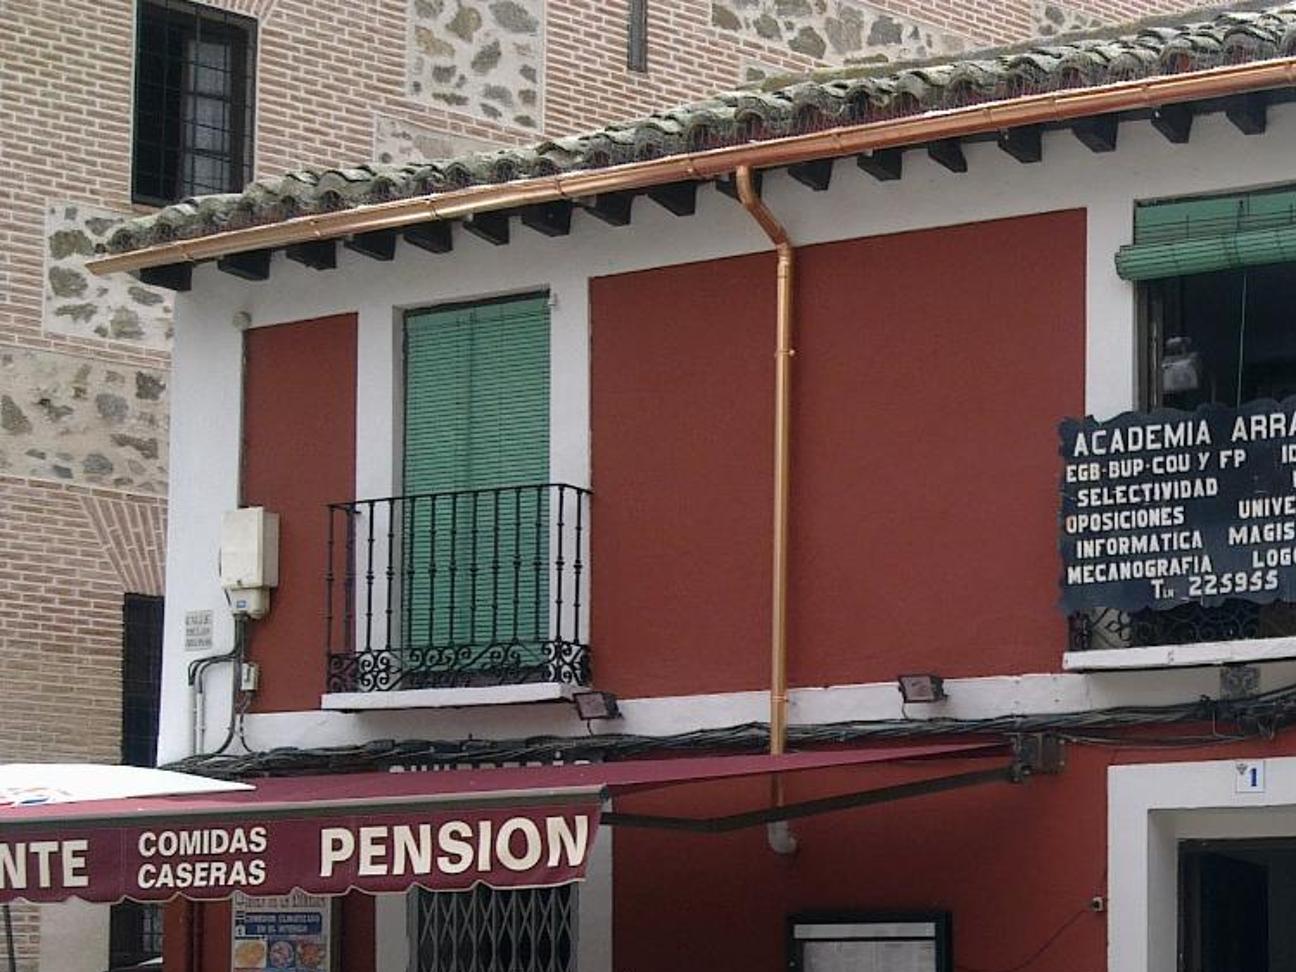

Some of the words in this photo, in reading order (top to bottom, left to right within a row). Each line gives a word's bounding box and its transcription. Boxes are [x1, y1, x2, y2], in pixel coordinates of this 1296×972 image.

[1073, 419, 1211, 457] ACADEMIA
[1199, 452, 1210, 470] Y
[1220, 449, 1246, 469] FP
[1077, 478, 1218, 507] SELECTIVIDAD
[1066, 506, 1185, 534] OPOSICIONES
[1077, 530, 1203, 559] INFORMATICA
[1067, 555, 1212, 585] MECANOGRAFIA
[1189, 570, 1278, 597] 225955
[1250, 767, 1258, 787] 1
[138, 827, 268, 857] COMIDAS
[320, 814, 588, 877] PENSION
[138, 859, 266, 889] CASERAS
